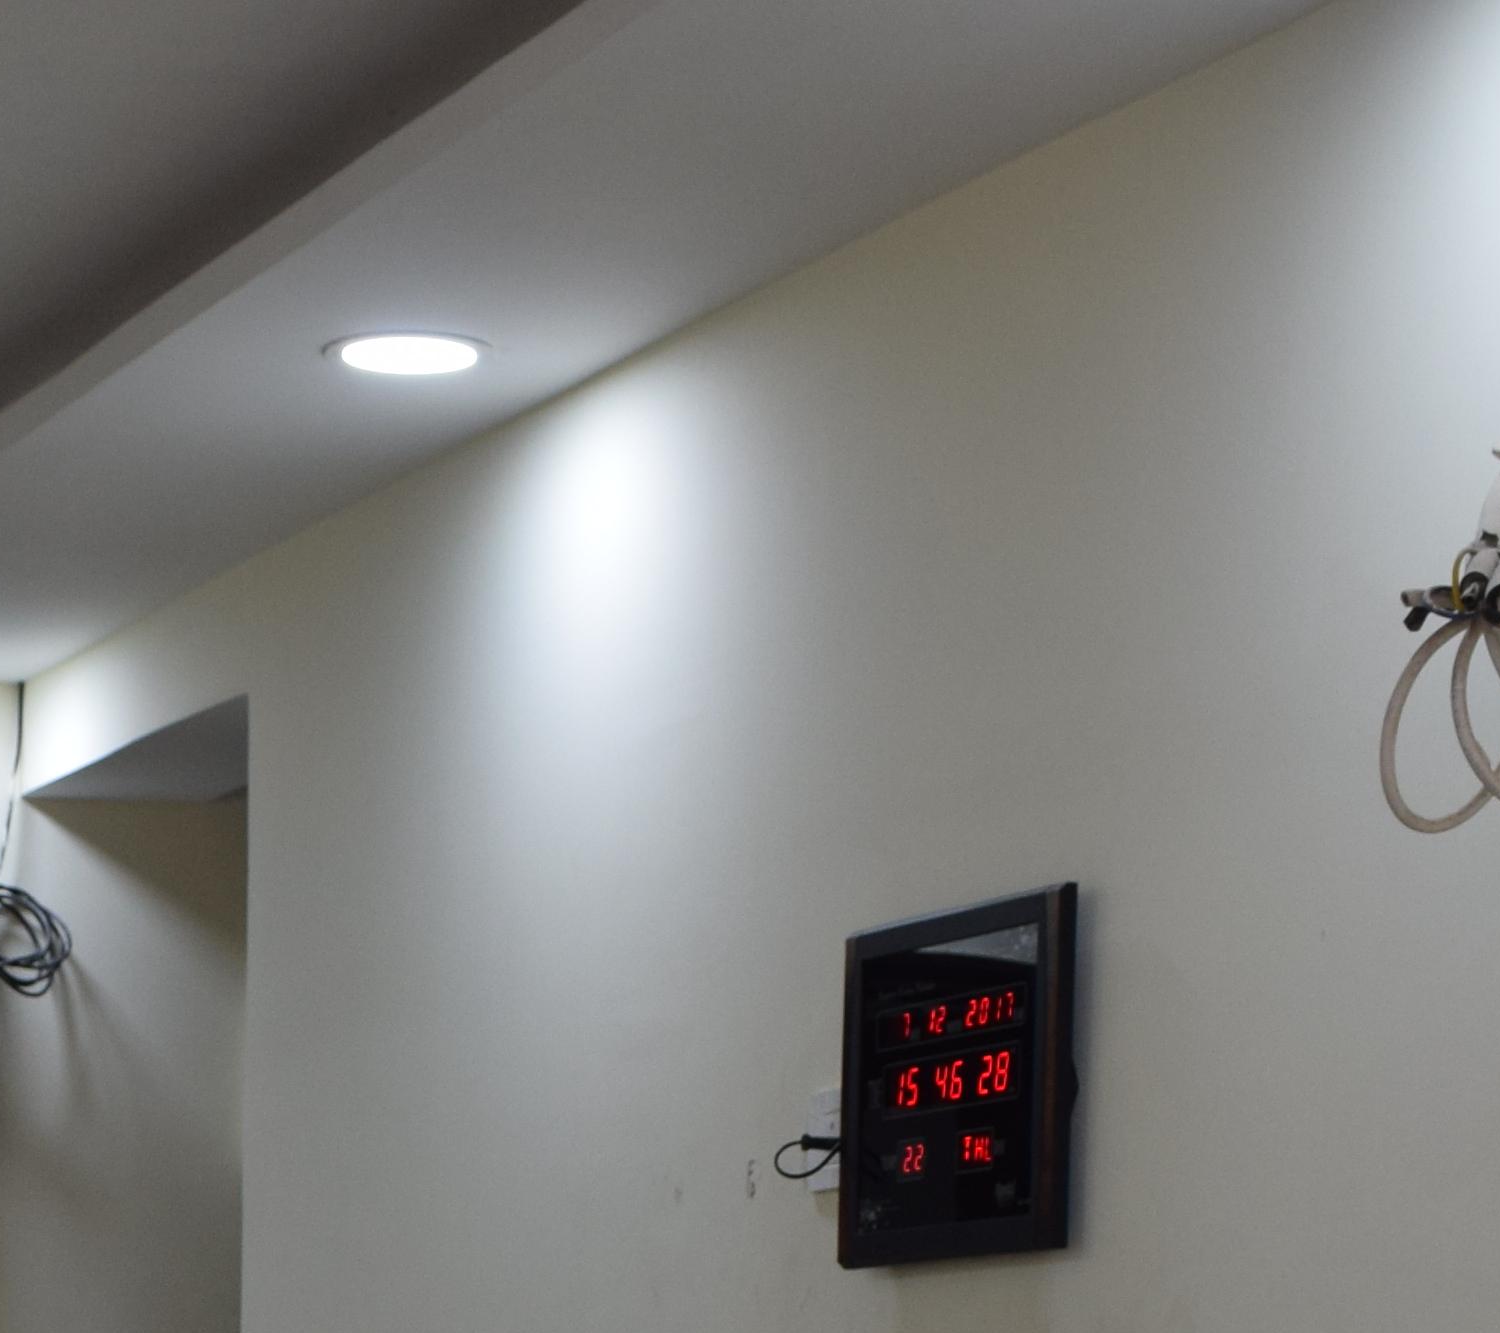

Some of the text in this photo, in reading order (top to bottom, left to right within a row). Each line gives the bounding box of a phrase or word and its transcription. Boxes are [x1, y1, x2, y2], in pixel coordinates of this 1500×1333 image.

[927, 1004, 948, 1035] 12
[963, 990, 1017, 1029] 2017
[896, 1049, 1012, 1108] 15 46 28
[902, 1143, 926, 1175] 22
